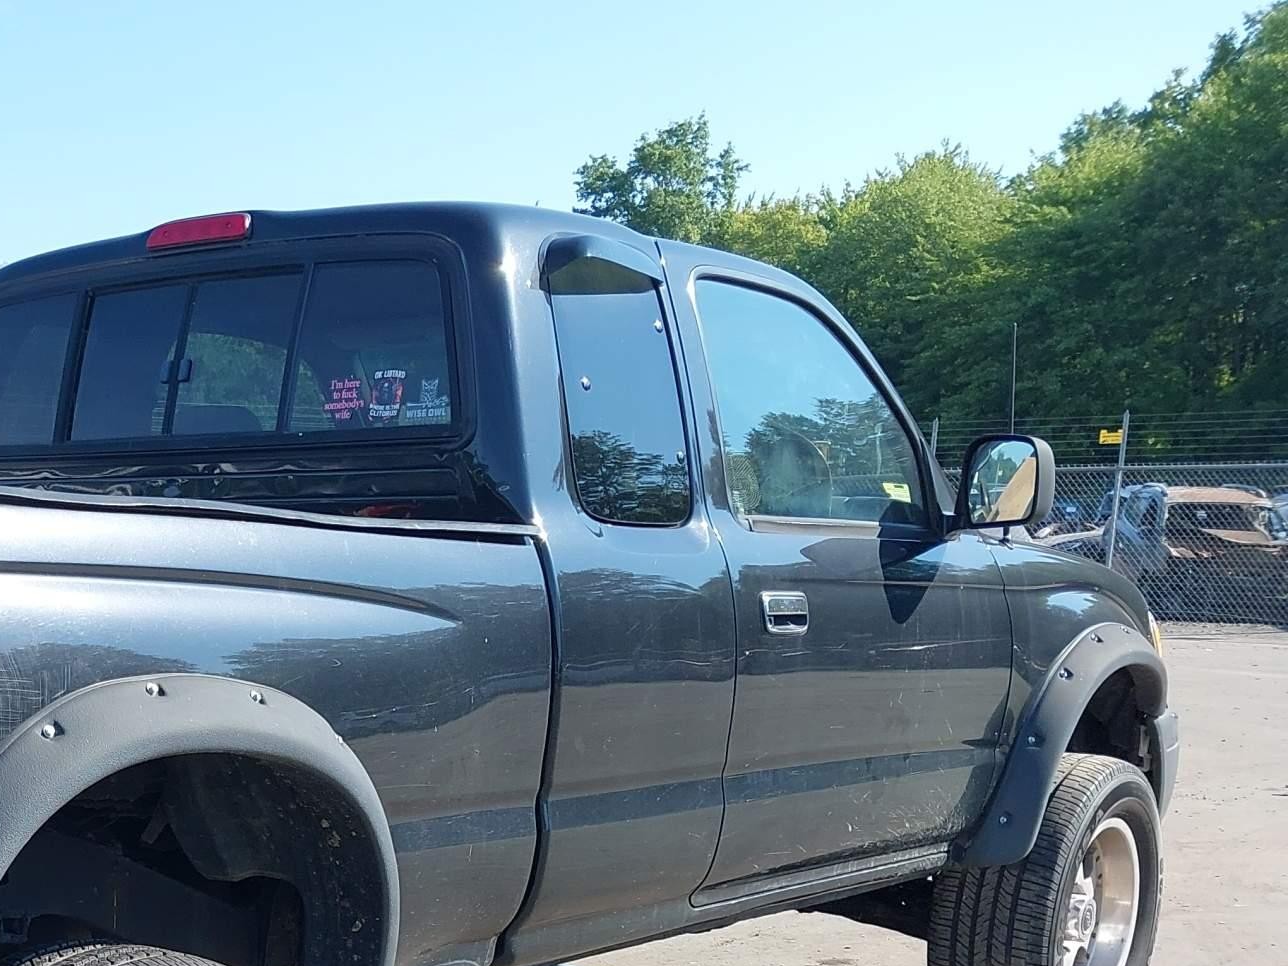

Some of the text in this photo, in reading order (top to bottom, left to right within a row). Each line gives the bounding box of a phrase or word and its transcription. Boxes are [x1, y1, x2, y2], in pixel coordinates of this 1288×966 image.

[331, 379, 361, 389] I'm here
[333, 389, 358, 399] to fuck
[323, 399, 364, 410] somebody's
[335, 410, 352, 419] wife
[406, 408, 447, 418] WISE OWL
